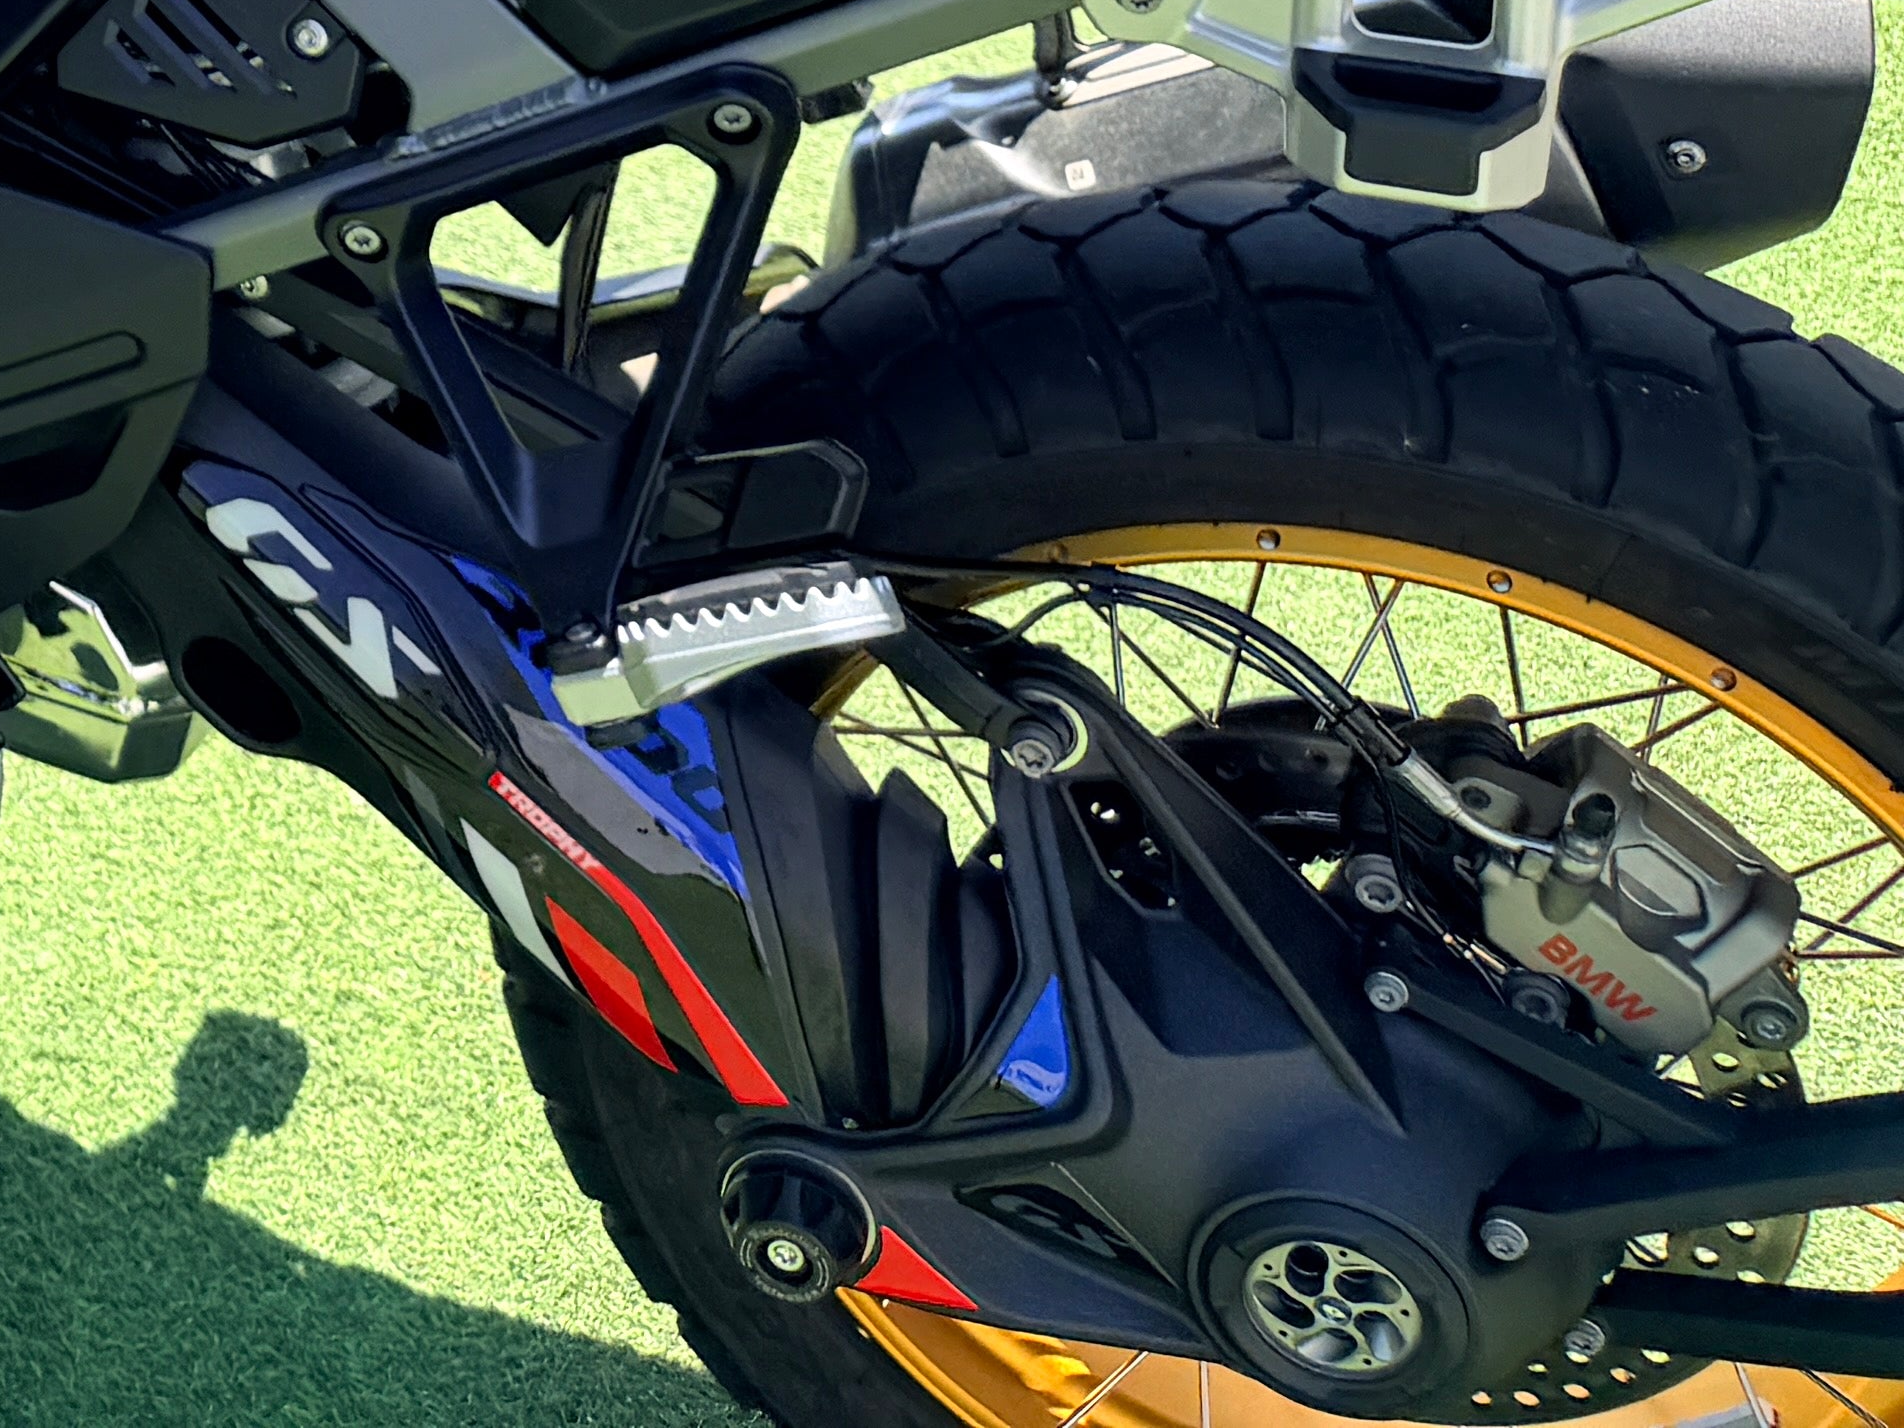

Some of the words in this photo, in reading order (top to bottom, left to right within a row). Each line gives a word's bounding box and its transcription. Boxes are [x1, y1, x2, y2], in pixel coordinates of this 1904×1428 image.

[205, 497, 442, 700] GS
[494, 774, 604, 871] TROPHY
[1538, 932, 1659, 1022] BMW
